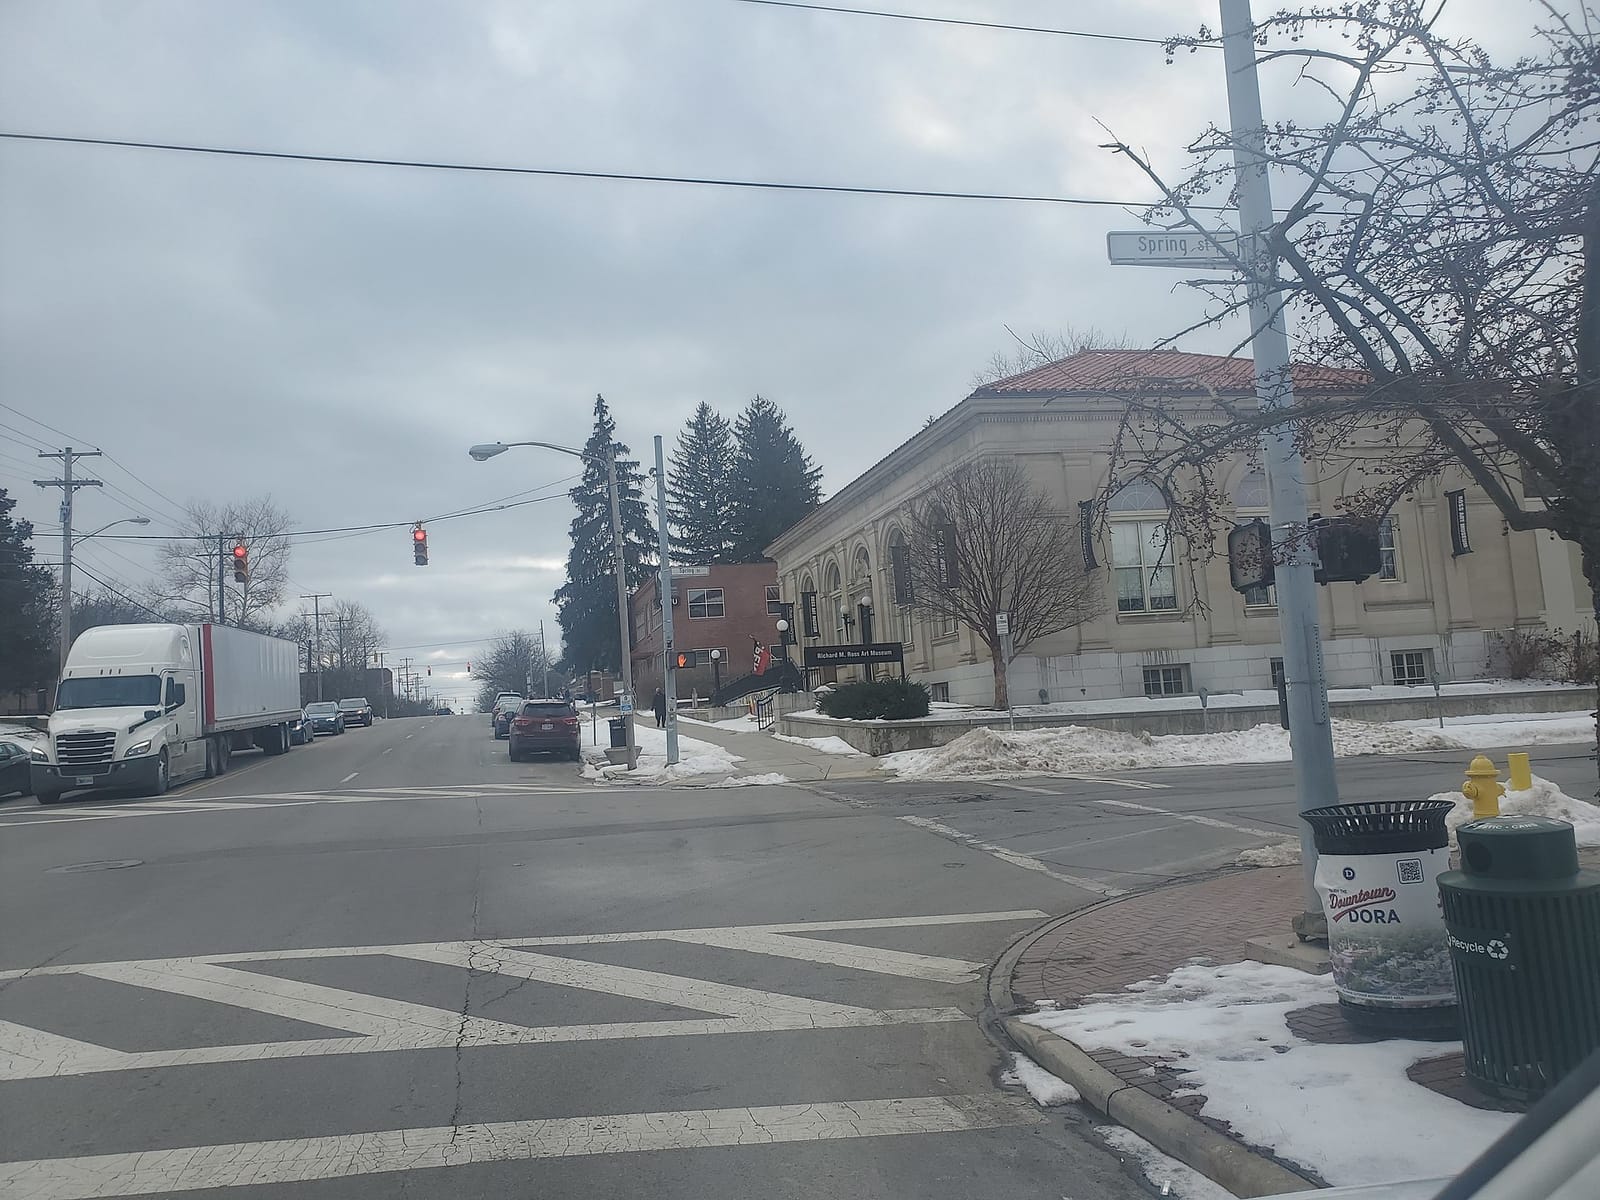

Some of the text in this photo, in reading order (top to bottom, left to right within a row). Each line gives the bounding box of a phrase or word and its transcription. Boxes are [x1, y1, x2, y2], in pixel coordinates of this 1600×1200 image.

[1138, 236, 1188, 255] Spring
[1328, 887, 1393, 909] Downtown
[1348, 909, 1401, 923] DORA
[1451, 935, 1485, 953] Recycle
